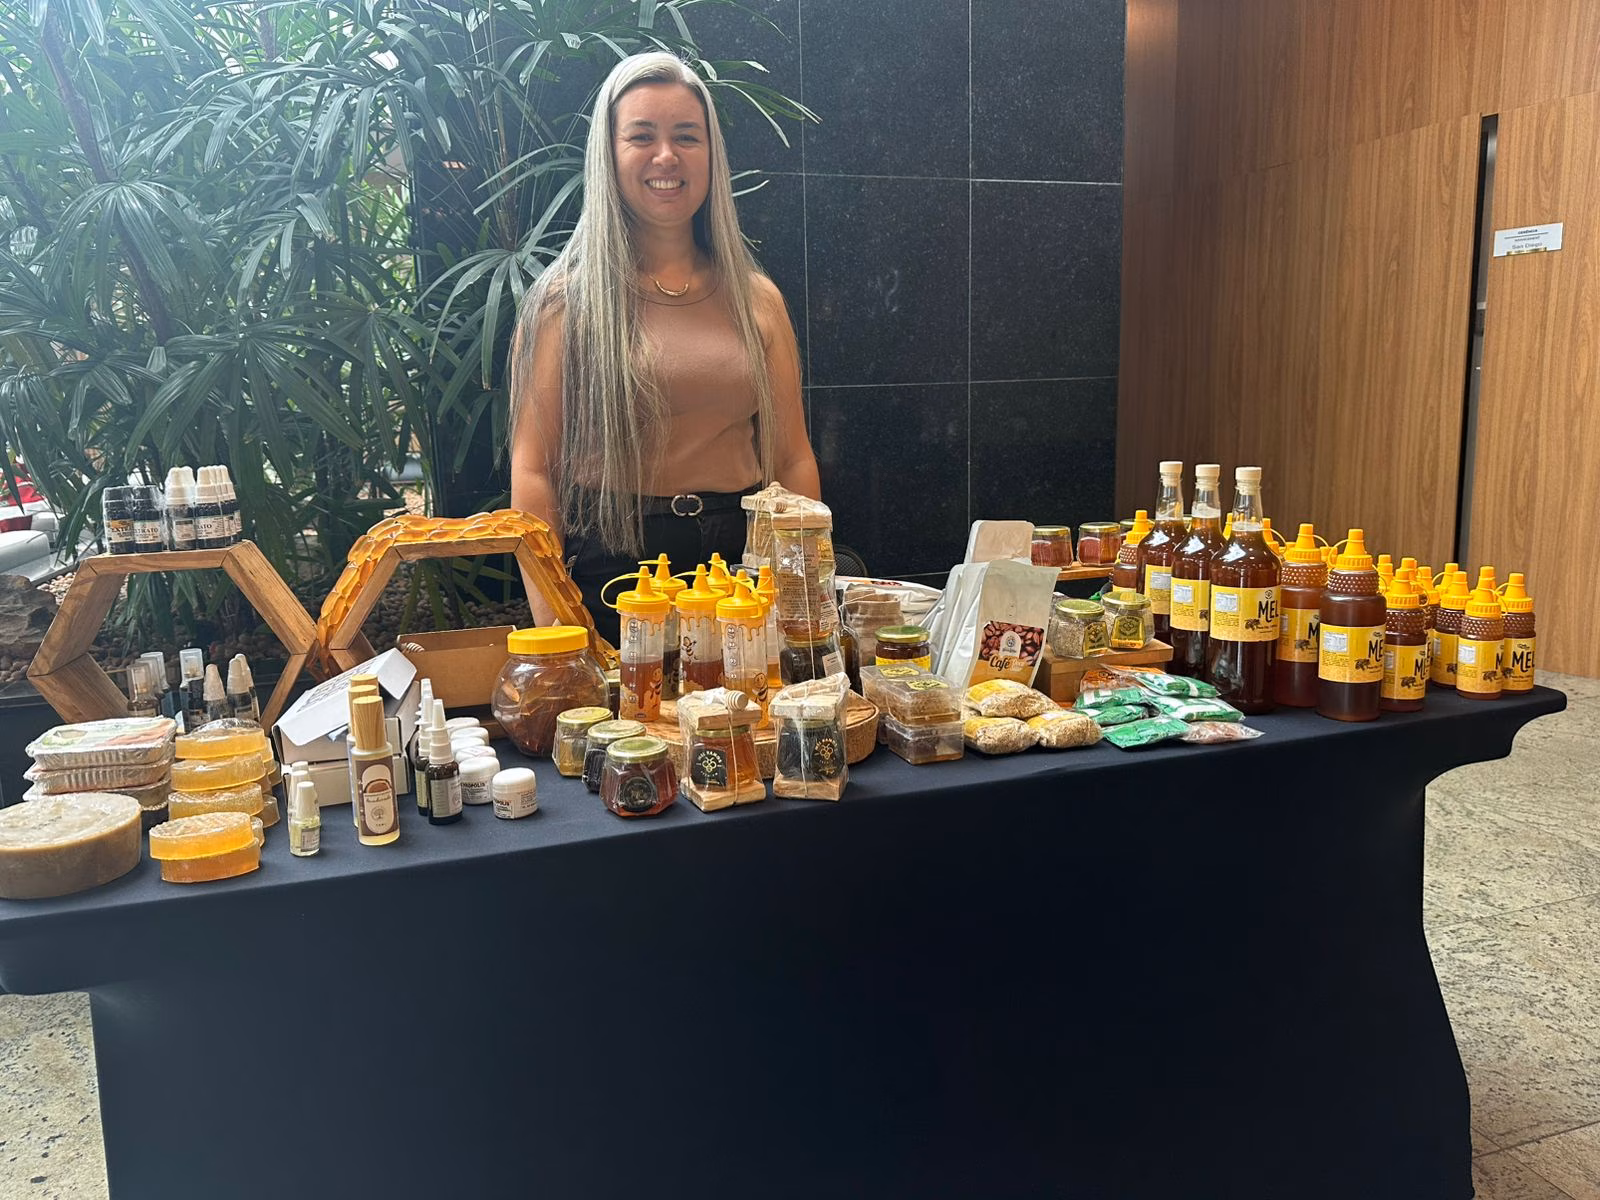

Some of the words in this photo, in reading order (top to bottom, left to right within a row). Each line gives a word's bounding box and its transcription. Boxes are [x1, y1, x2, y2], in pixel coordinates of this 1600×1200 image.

[1258, 600, 1279, 622] MEL
[1368, 639, 1384, 662] ME
[990, 656, 1010, 671] Café
[1512, 651, 1535, 673] MEL
